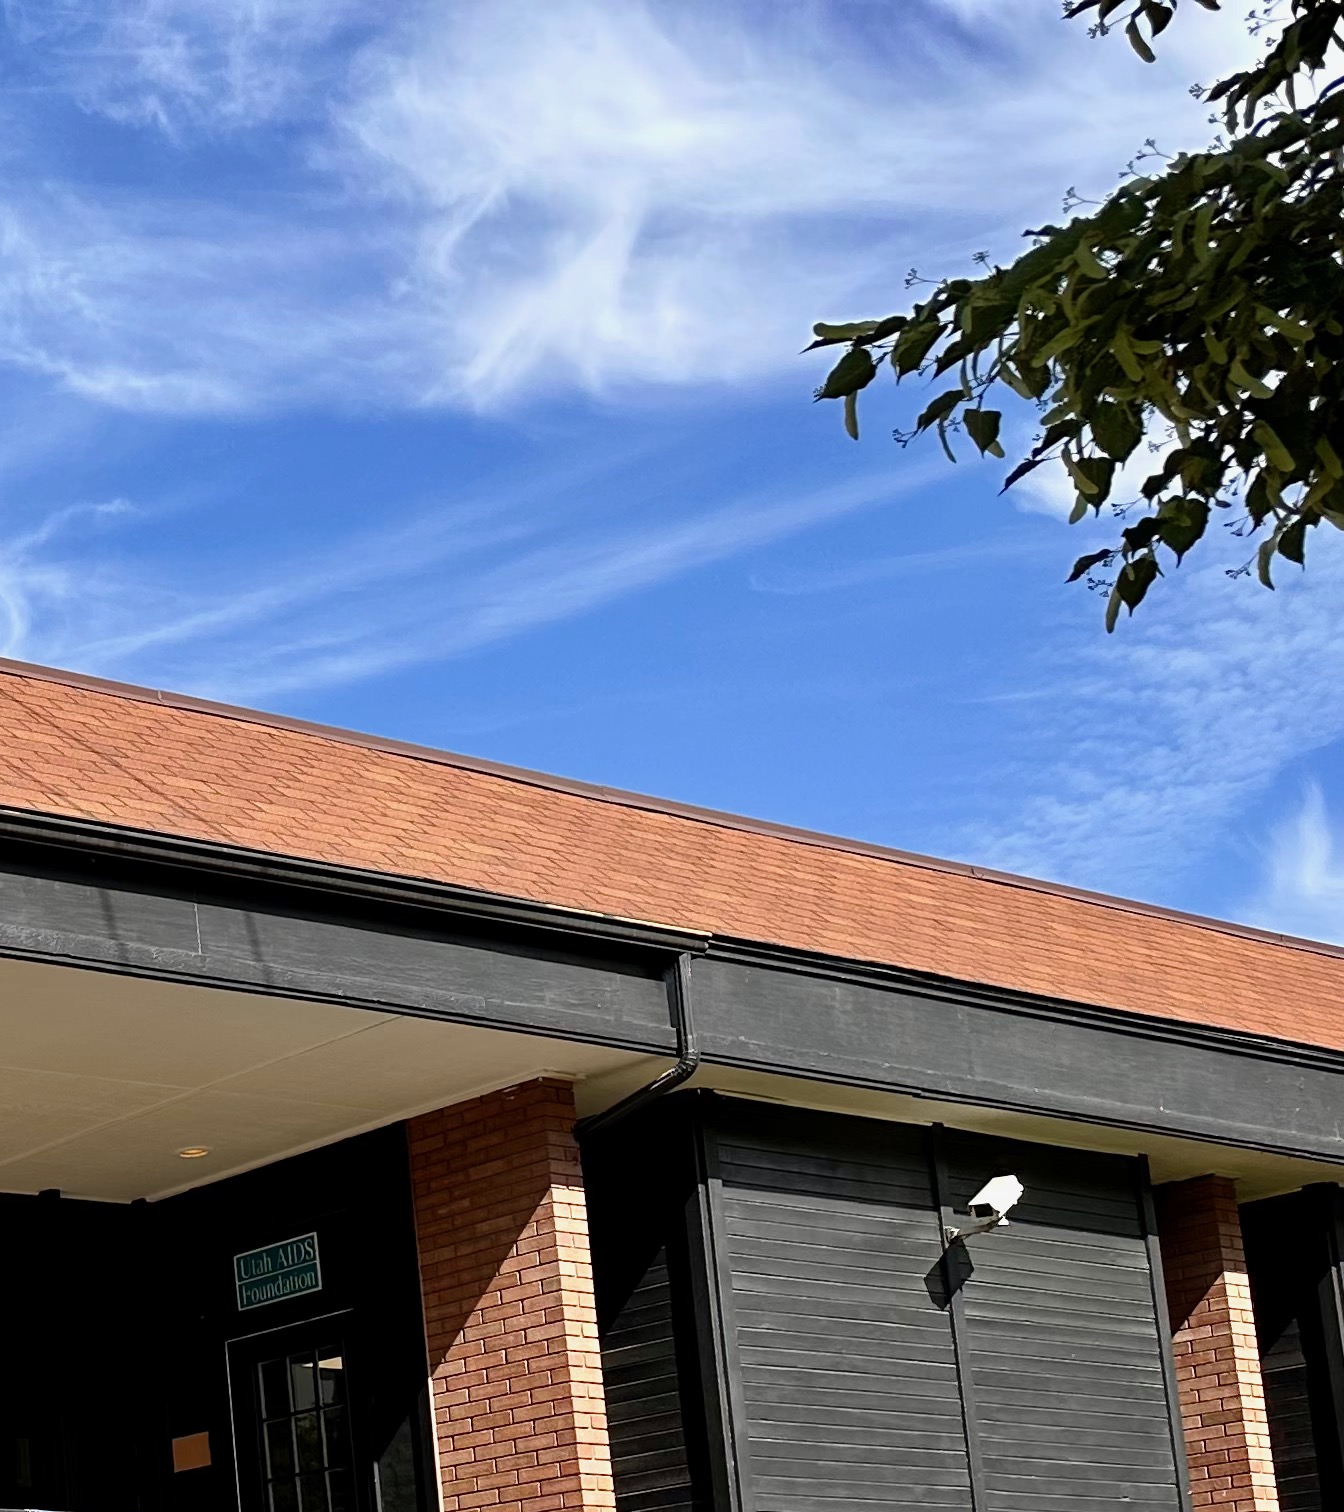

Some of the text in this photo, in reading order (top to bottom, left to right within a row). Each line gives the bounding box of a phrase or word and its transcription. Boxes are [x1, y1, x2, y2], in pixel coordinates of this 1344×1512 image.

[240, 1238, 314, 1279] Utah AIDS
[242, 1271, 316, 1305] Foundation
